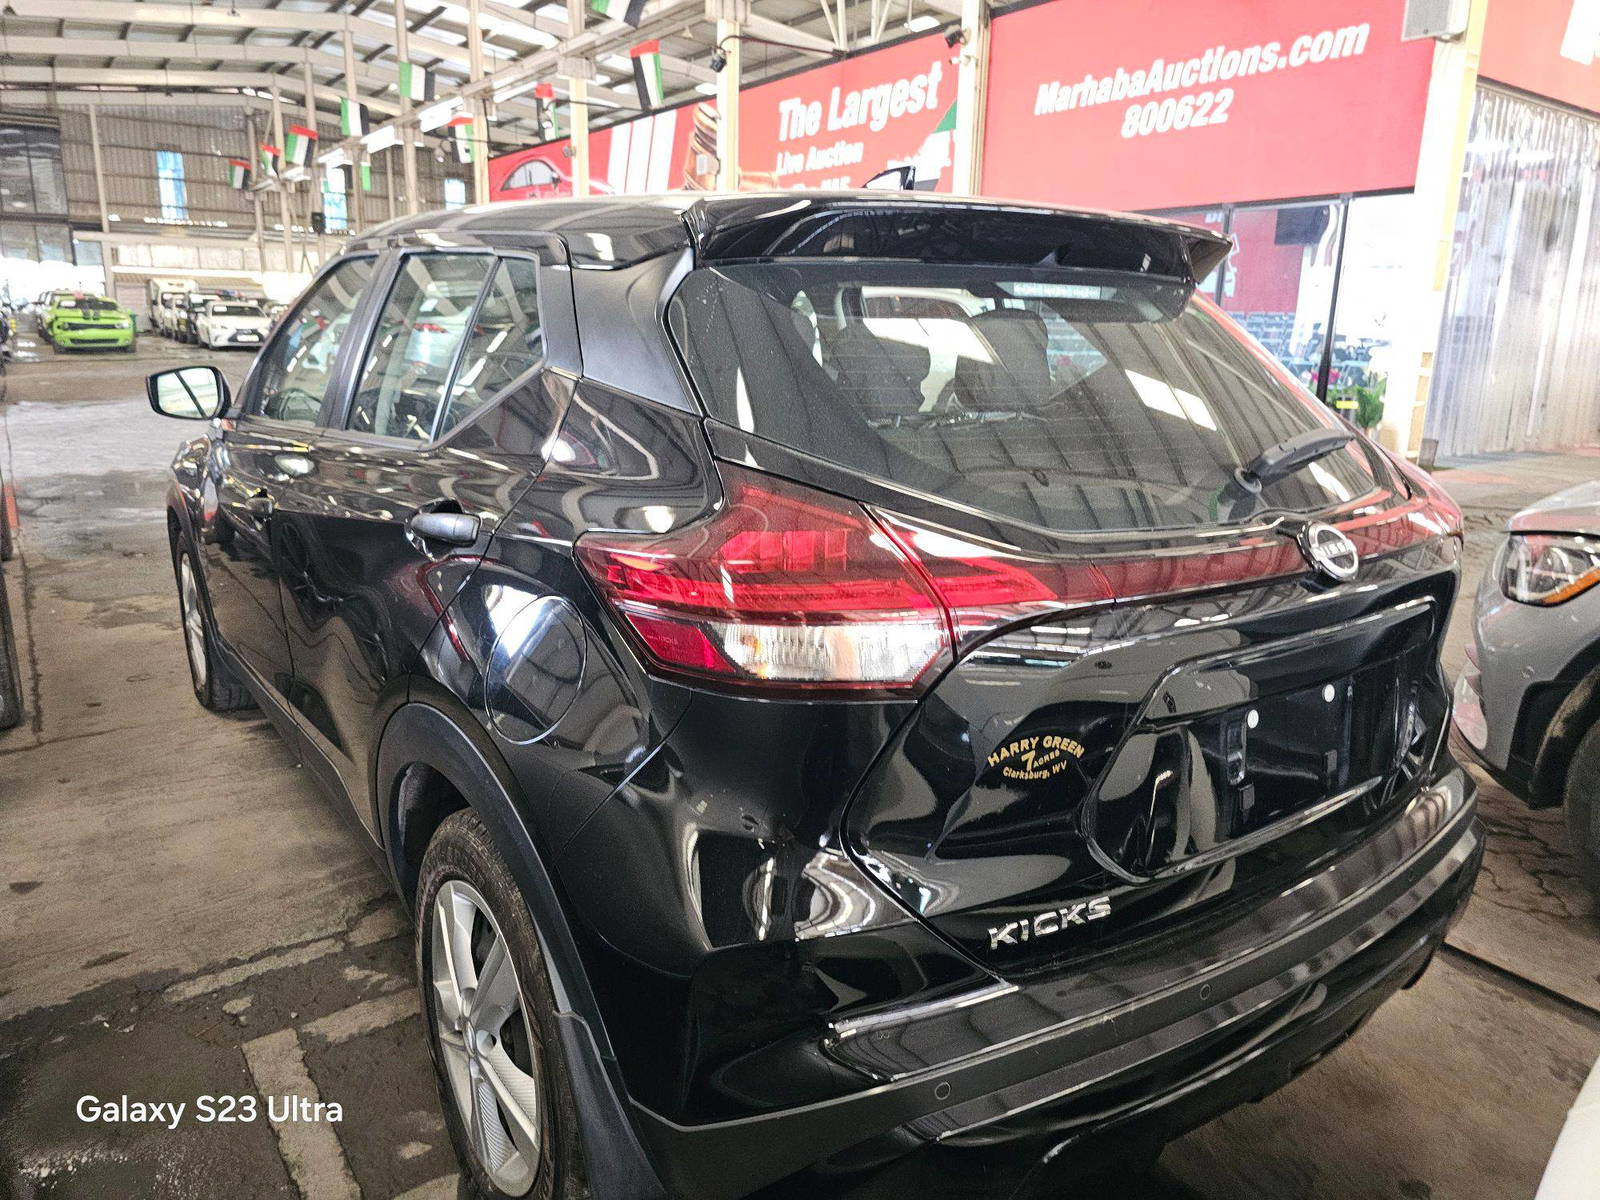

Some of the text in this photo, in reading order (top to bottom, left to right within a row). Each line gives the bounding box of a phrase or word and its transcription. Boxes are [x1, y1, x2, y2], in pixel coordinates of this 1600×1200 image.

[1034, 22, 1370, 116] MarhabaAuctions.com
[778, 60, 943, 142] The Largest
[1121, 87, 1235, 139] 800622
[776, 152, 804, 176] Live
[805, 140, 865, 172] Auction
[987, 735, 1085, 767] HARRY GREEN
[1021, 749, 1036, 771] 7
[1052, 759, 1067, 774] WV
[987, 895, 1112, 951] KICKS
